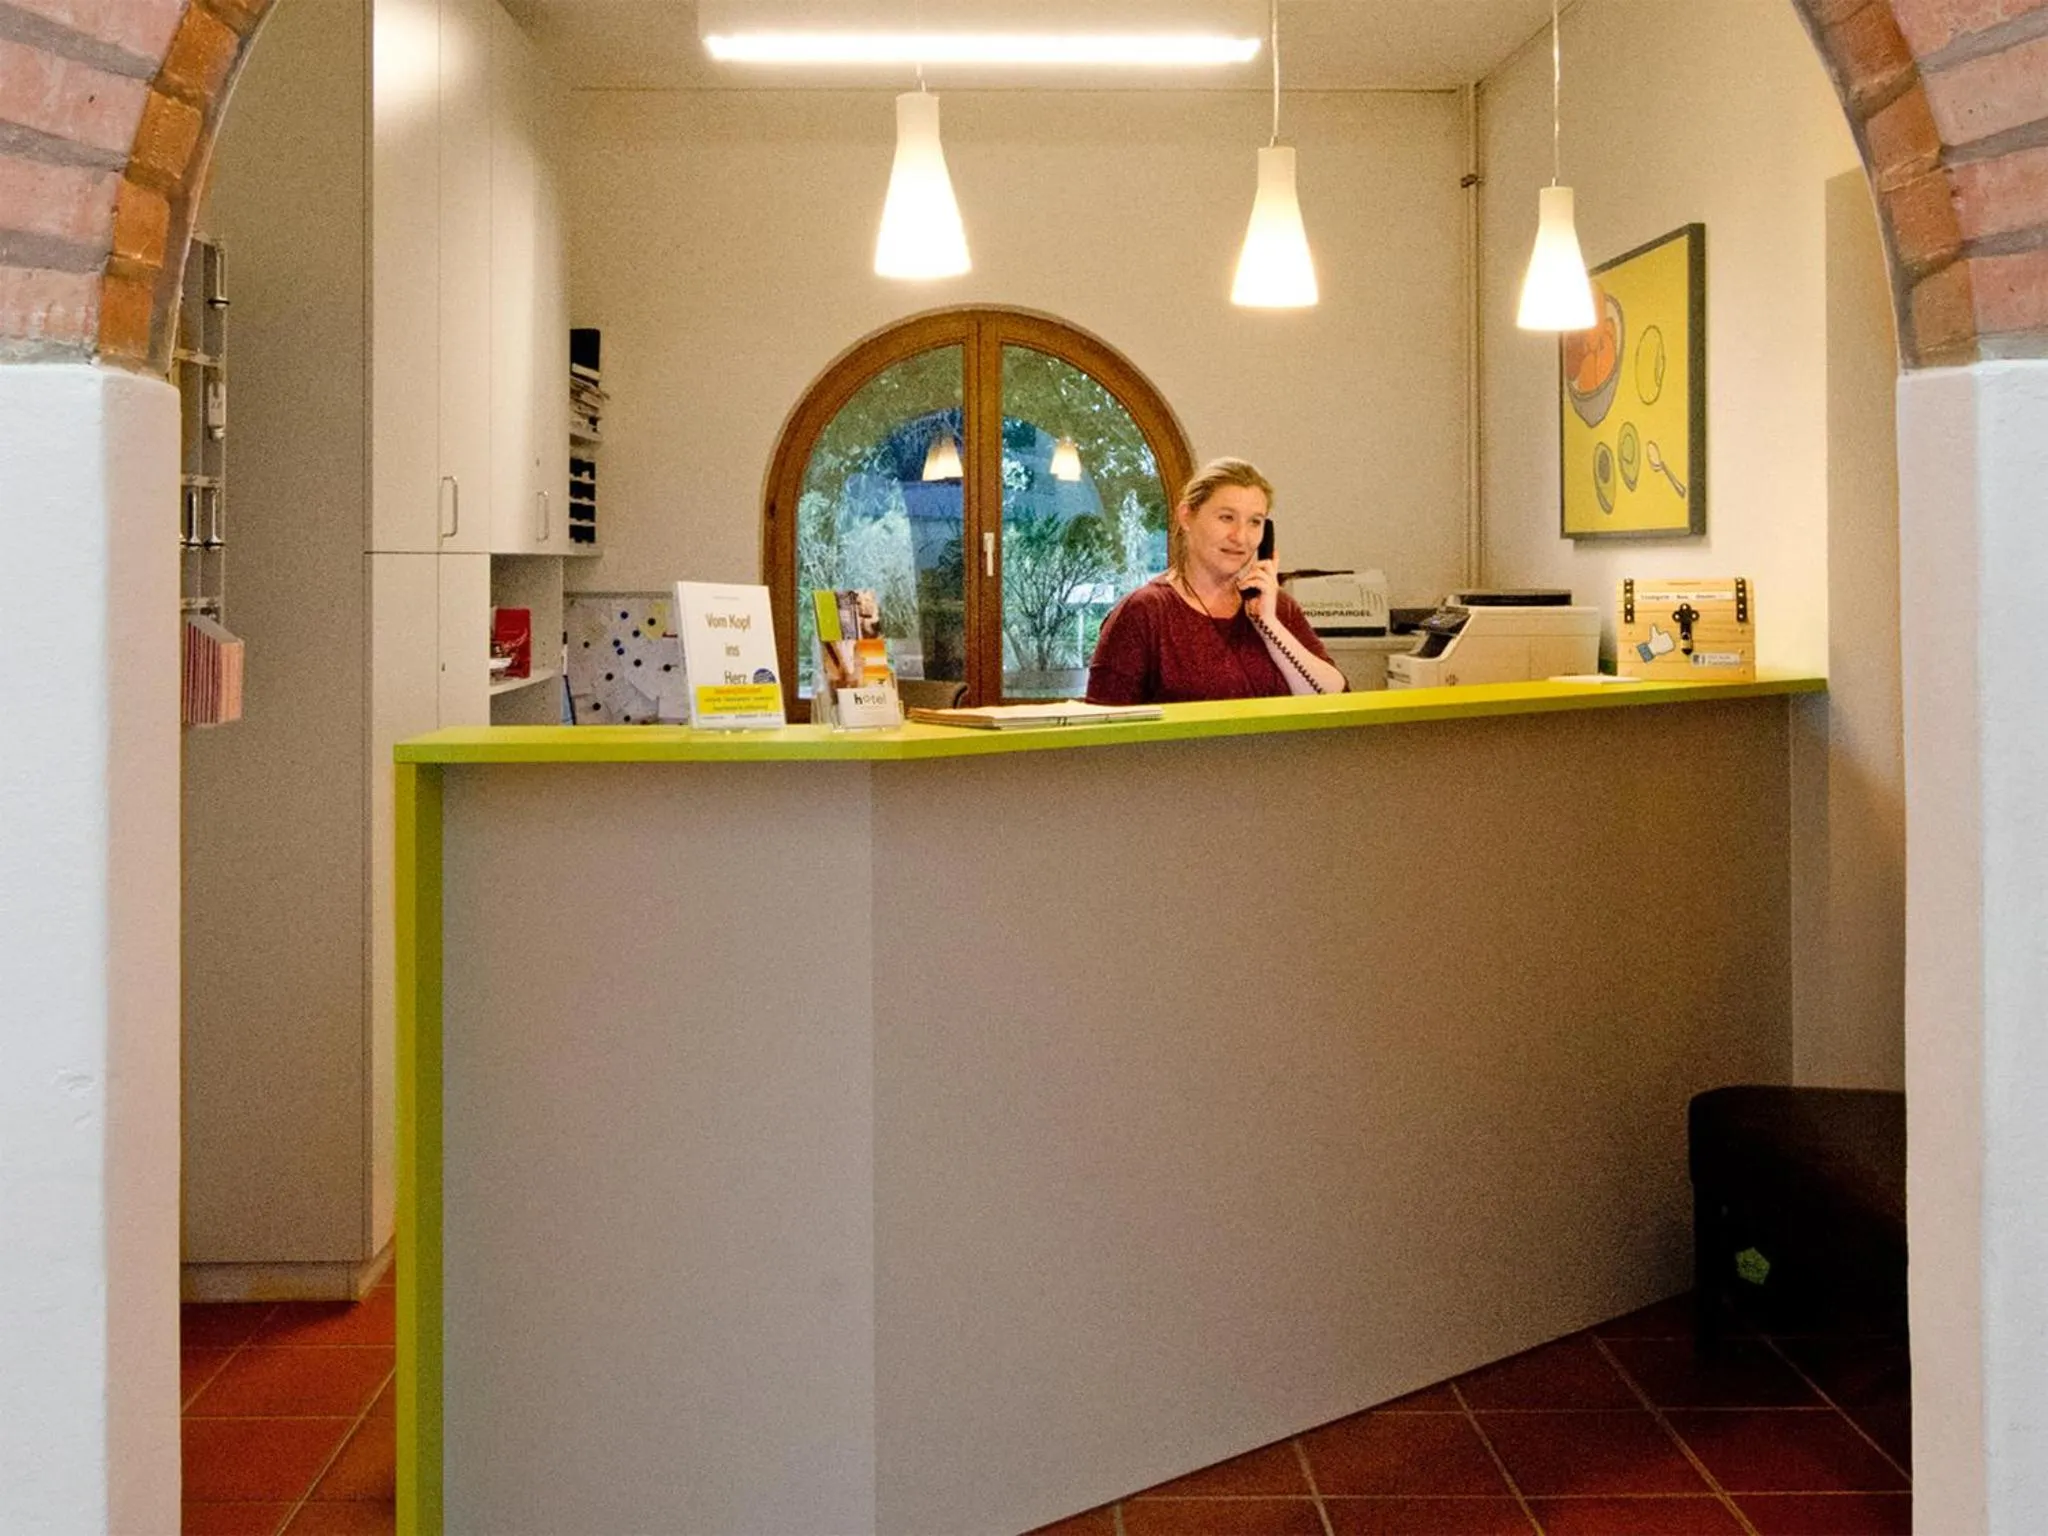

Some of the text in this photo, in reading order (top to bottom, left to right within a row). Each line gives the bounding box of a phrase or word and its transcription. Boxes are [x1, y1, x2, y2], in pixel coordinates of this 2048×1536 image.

[1303, 609, 1371, 618] RÜNSPARGEL
[705, 613, 751, 632] Vom Kopf
[725, 643, 740, 657] ins
[724, 671, 748, 685] Herz
[854, 692, 887, 706] hotel
